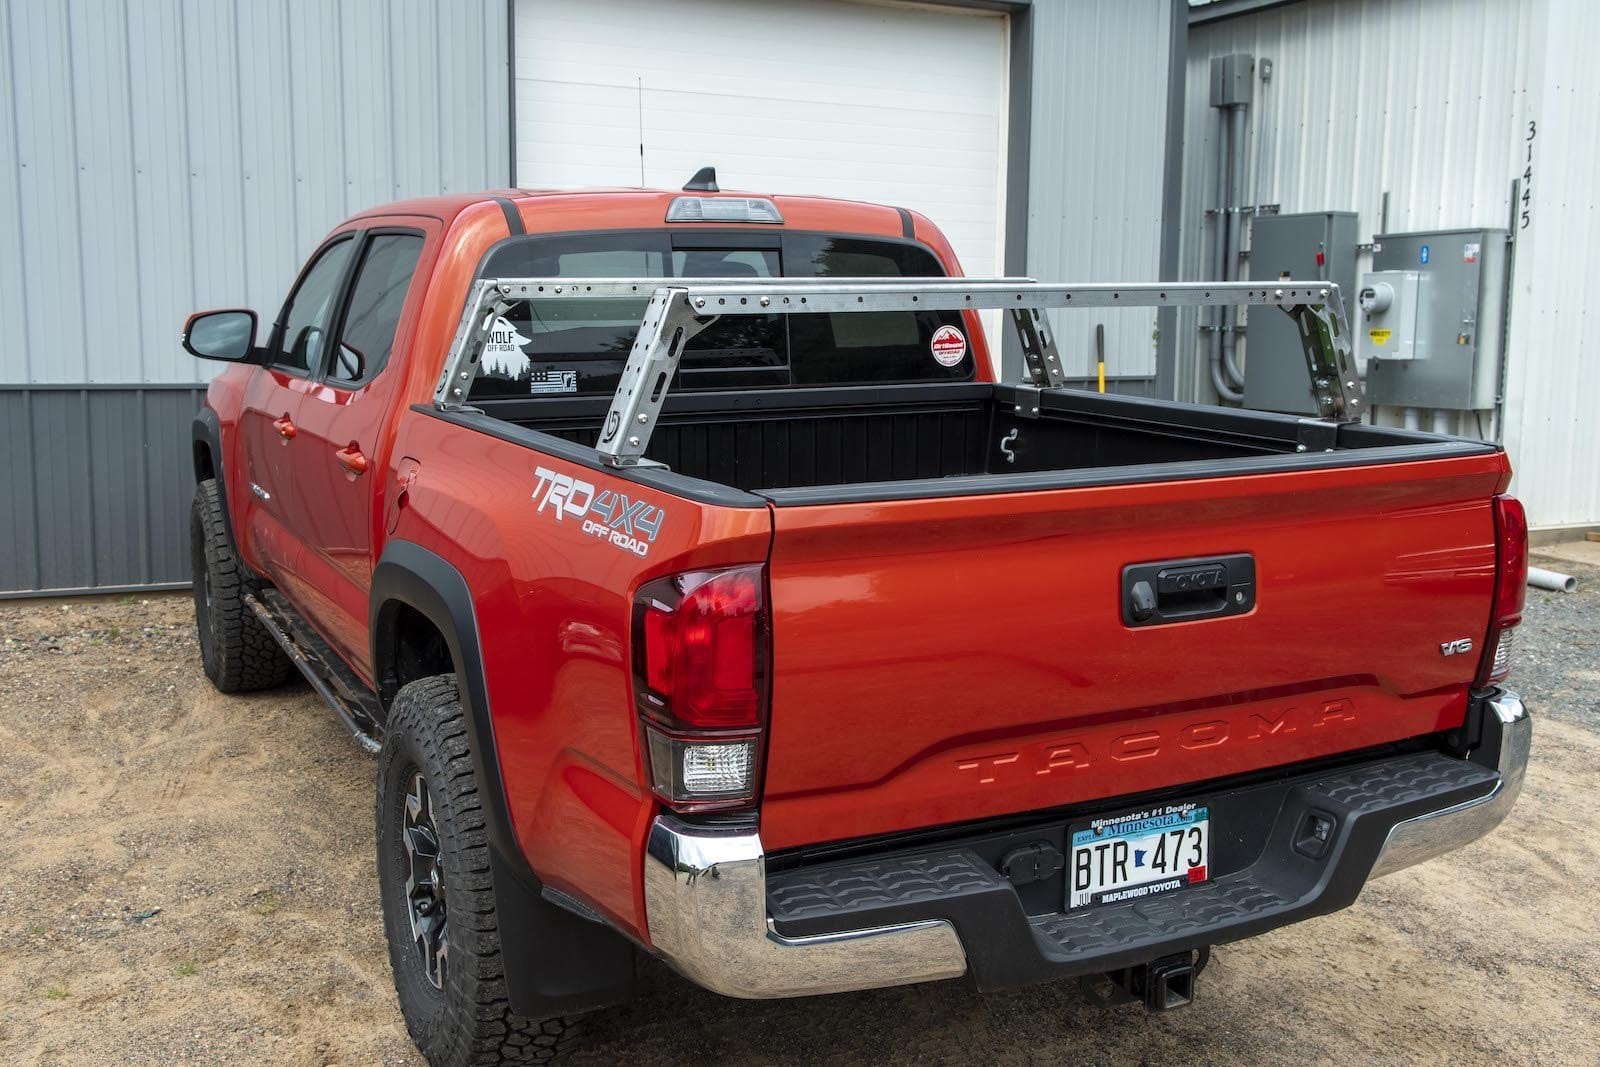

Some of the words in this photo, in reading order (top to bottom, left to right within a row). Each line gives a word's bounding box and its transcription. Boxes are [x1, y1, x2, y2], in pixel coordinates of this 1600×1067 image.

[1521, 121, 1536, 229] 31445
[487, 331, 514, 344] WOLF
[531, 465, 595, 521] TRD
[582, 519, 609, 538] OFF
[608, 530, 649, 557] ROAD
[1167, 571, 1223, 588] TOYOTA
[1440, 638, 1472, 656] V6
[955, 698, 1356, 784] TACOMA
[1091, 810, 1149, 828] Minnesota's
[1152, 807, 1163, 817] #1
[1165, 803, 1197, 815] Dealer
[1076, 840, 1128, 891] BTR
[1151, 826, 1203, 874] 473
[1102, 887, 1148, 904] MAPLEWOOD
[1148, 880, 1181, 894] TOYOTA
